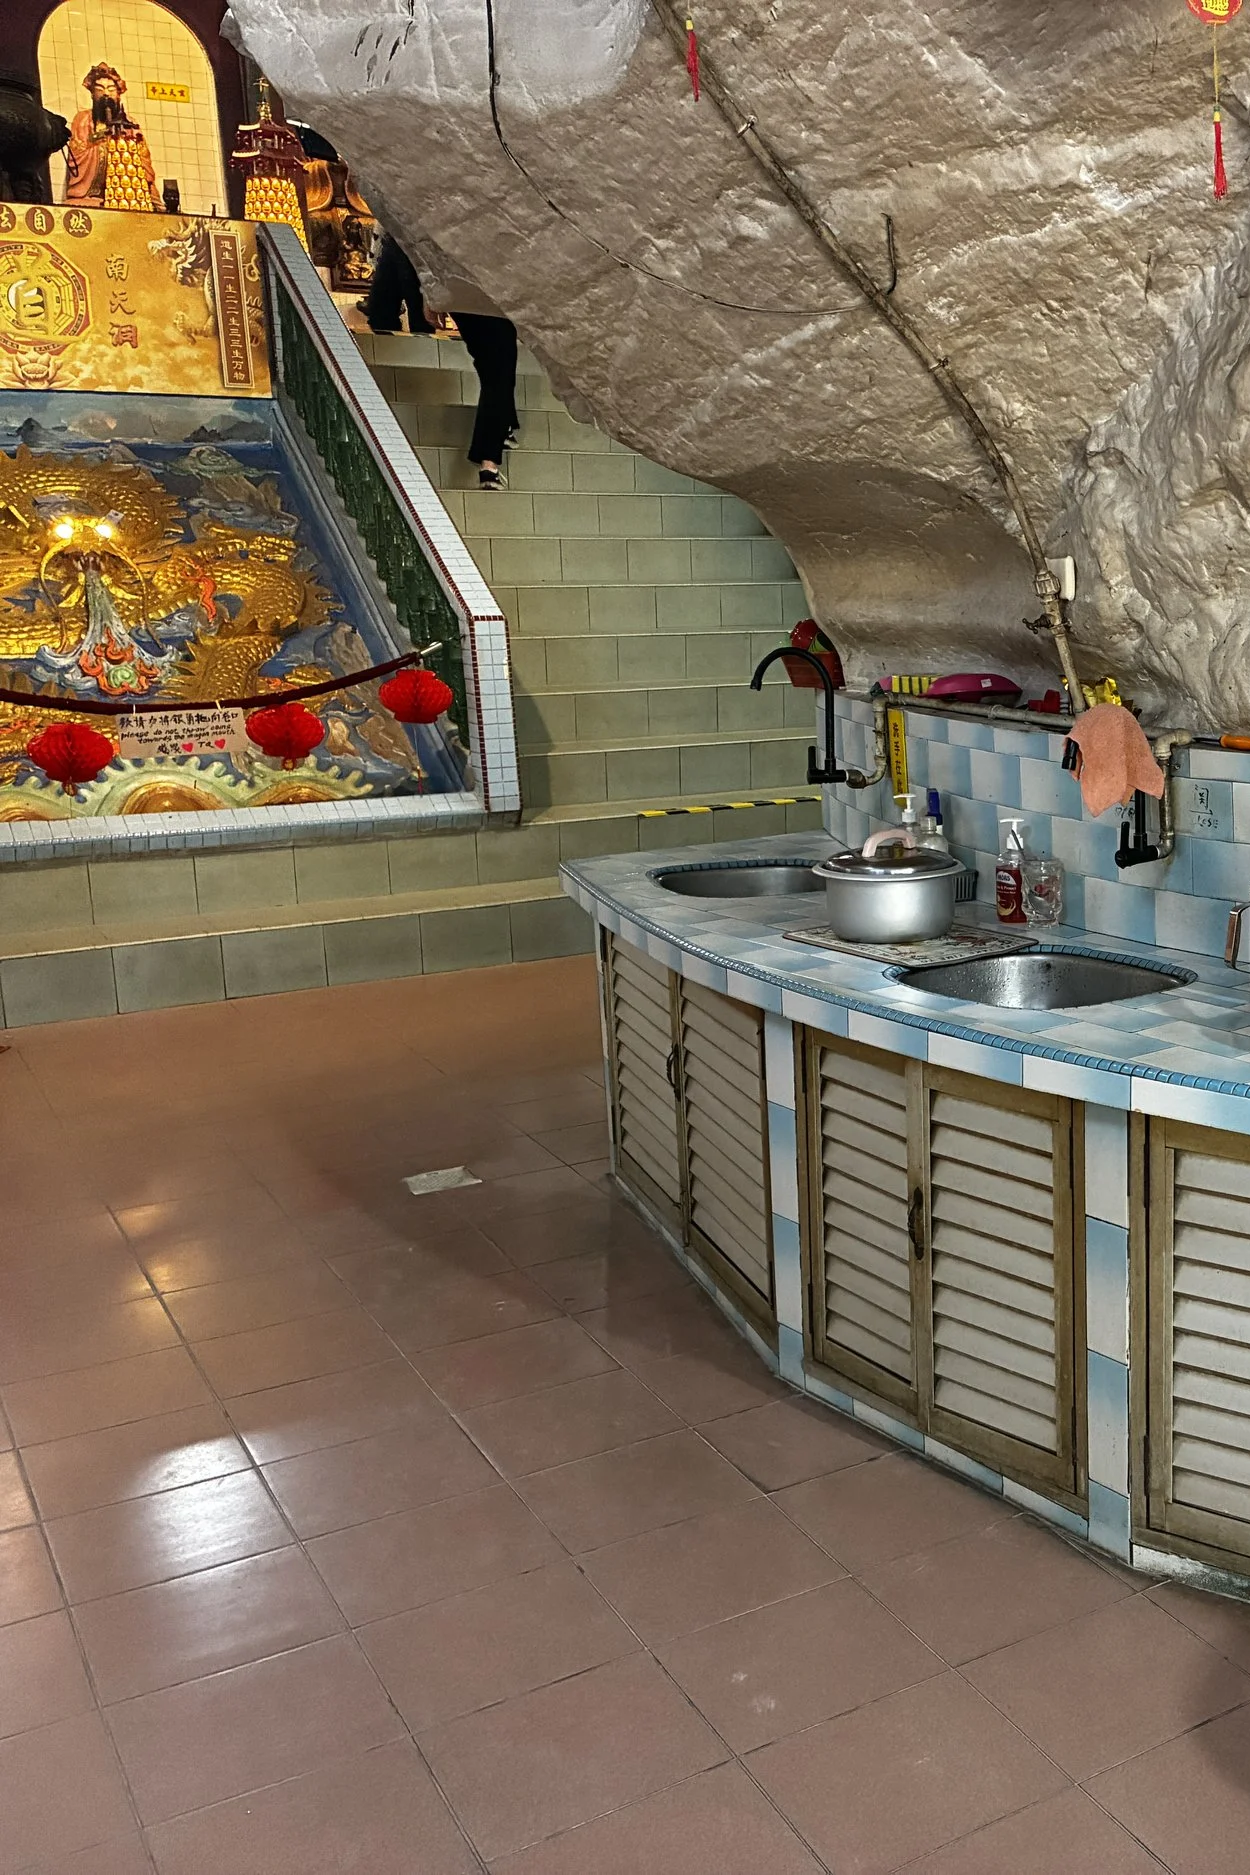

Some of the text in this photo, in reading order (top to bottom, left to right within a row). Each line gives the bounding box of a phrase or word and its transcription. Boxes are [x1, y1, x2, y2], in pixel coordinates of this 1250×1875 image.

[105, 253, 138, 349] 南天洞
[153, 728, 162, 736] do
